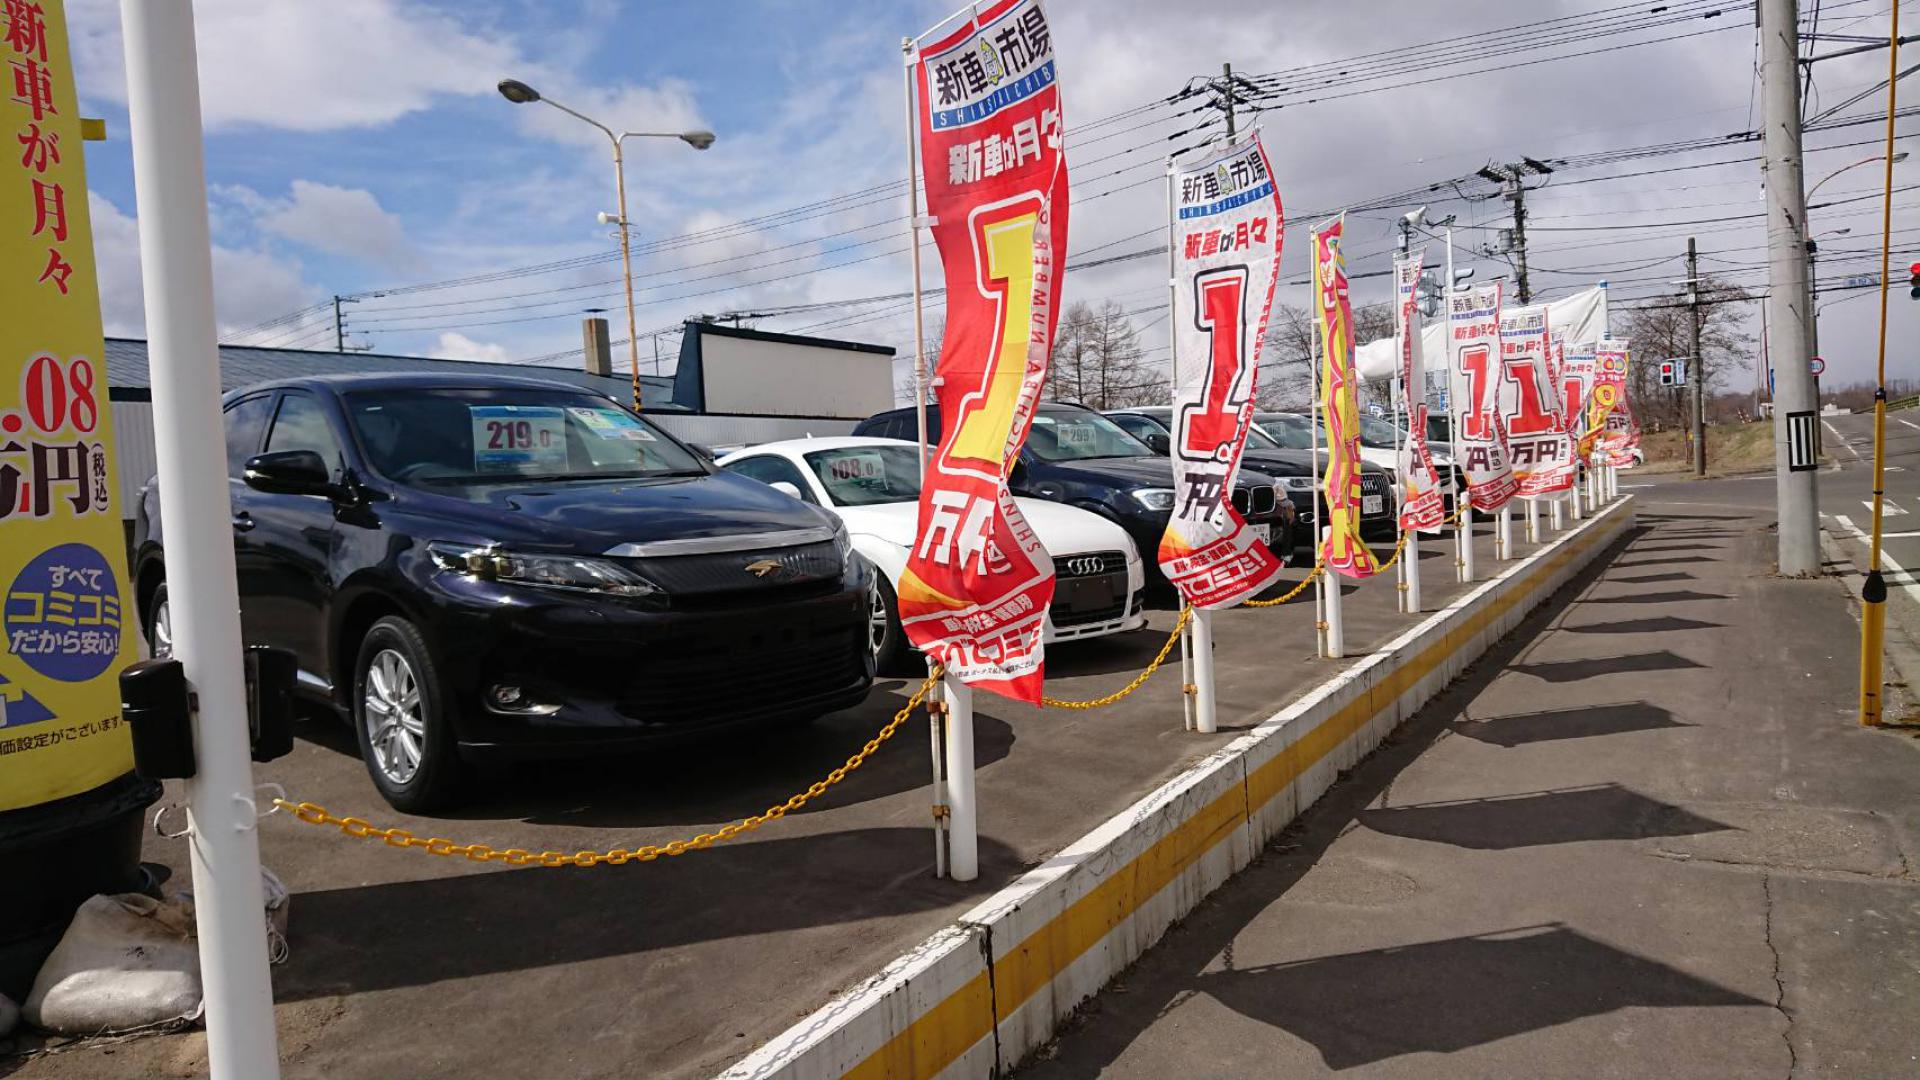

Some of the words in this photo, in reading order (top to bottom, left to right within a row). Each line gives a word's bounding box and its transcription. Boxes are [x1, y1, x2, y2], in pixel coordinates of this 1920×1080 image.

[2, 0, 73, 295] 新車が月々
[1184, 216, 1268, 260] 新車が月々
[1510, 439, 1559, 465] 万円
[48, 564, 103, 590] すべて
[7, 591, 120, 628] コミコミ
